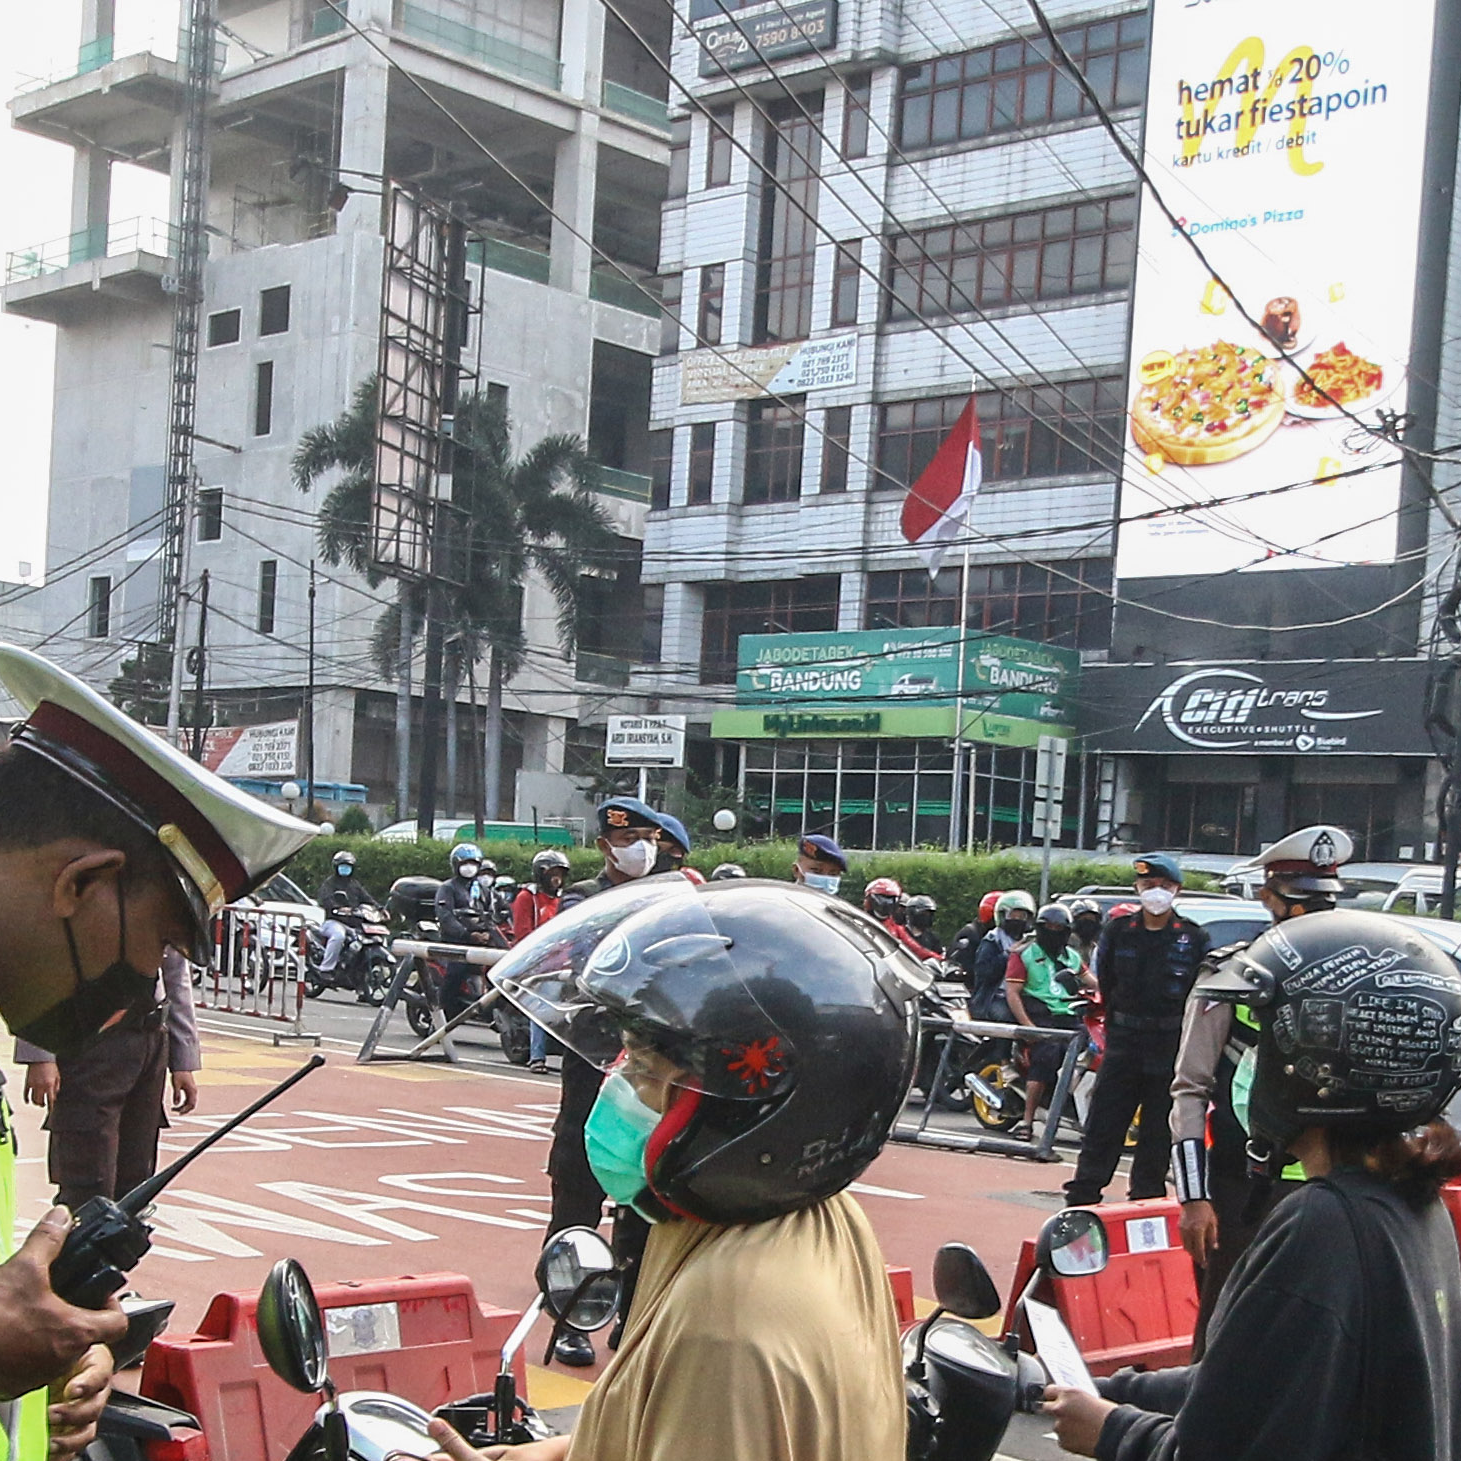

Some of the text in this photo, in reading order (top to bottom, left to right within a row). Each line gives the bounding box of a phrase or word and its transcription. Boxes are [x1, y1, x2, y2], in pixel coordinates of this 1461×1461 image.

[755, 29, 787, 49] 7590
[1178, 68, 1261, 107] hemat
[1289, 50, 1350, 83] 20%
[1176, 80, 1387, 140] tukar fiestapoin
[1172, 150, 1212, 168] kartu
[1217, 141, 1261, 160] kredit
[1276, 131, 1317, 150] debit
[1189, 209, 1304, 236] Domino's Pizza
[800, 343, 834, 355] HUBUNGI
[801, 360, 816, 369] 021
[756, 646, 854, 662] JABODETABEK
[770, 670, 862, 692] BANDUNG
[1265, 725, 1316, 733] SHUTTLE
[1358, 996, 1390, 1009] LIKE
[1396, 999, 1417, 1012] I'M
[1373, 1024, 1411, 1035] INSIDE
